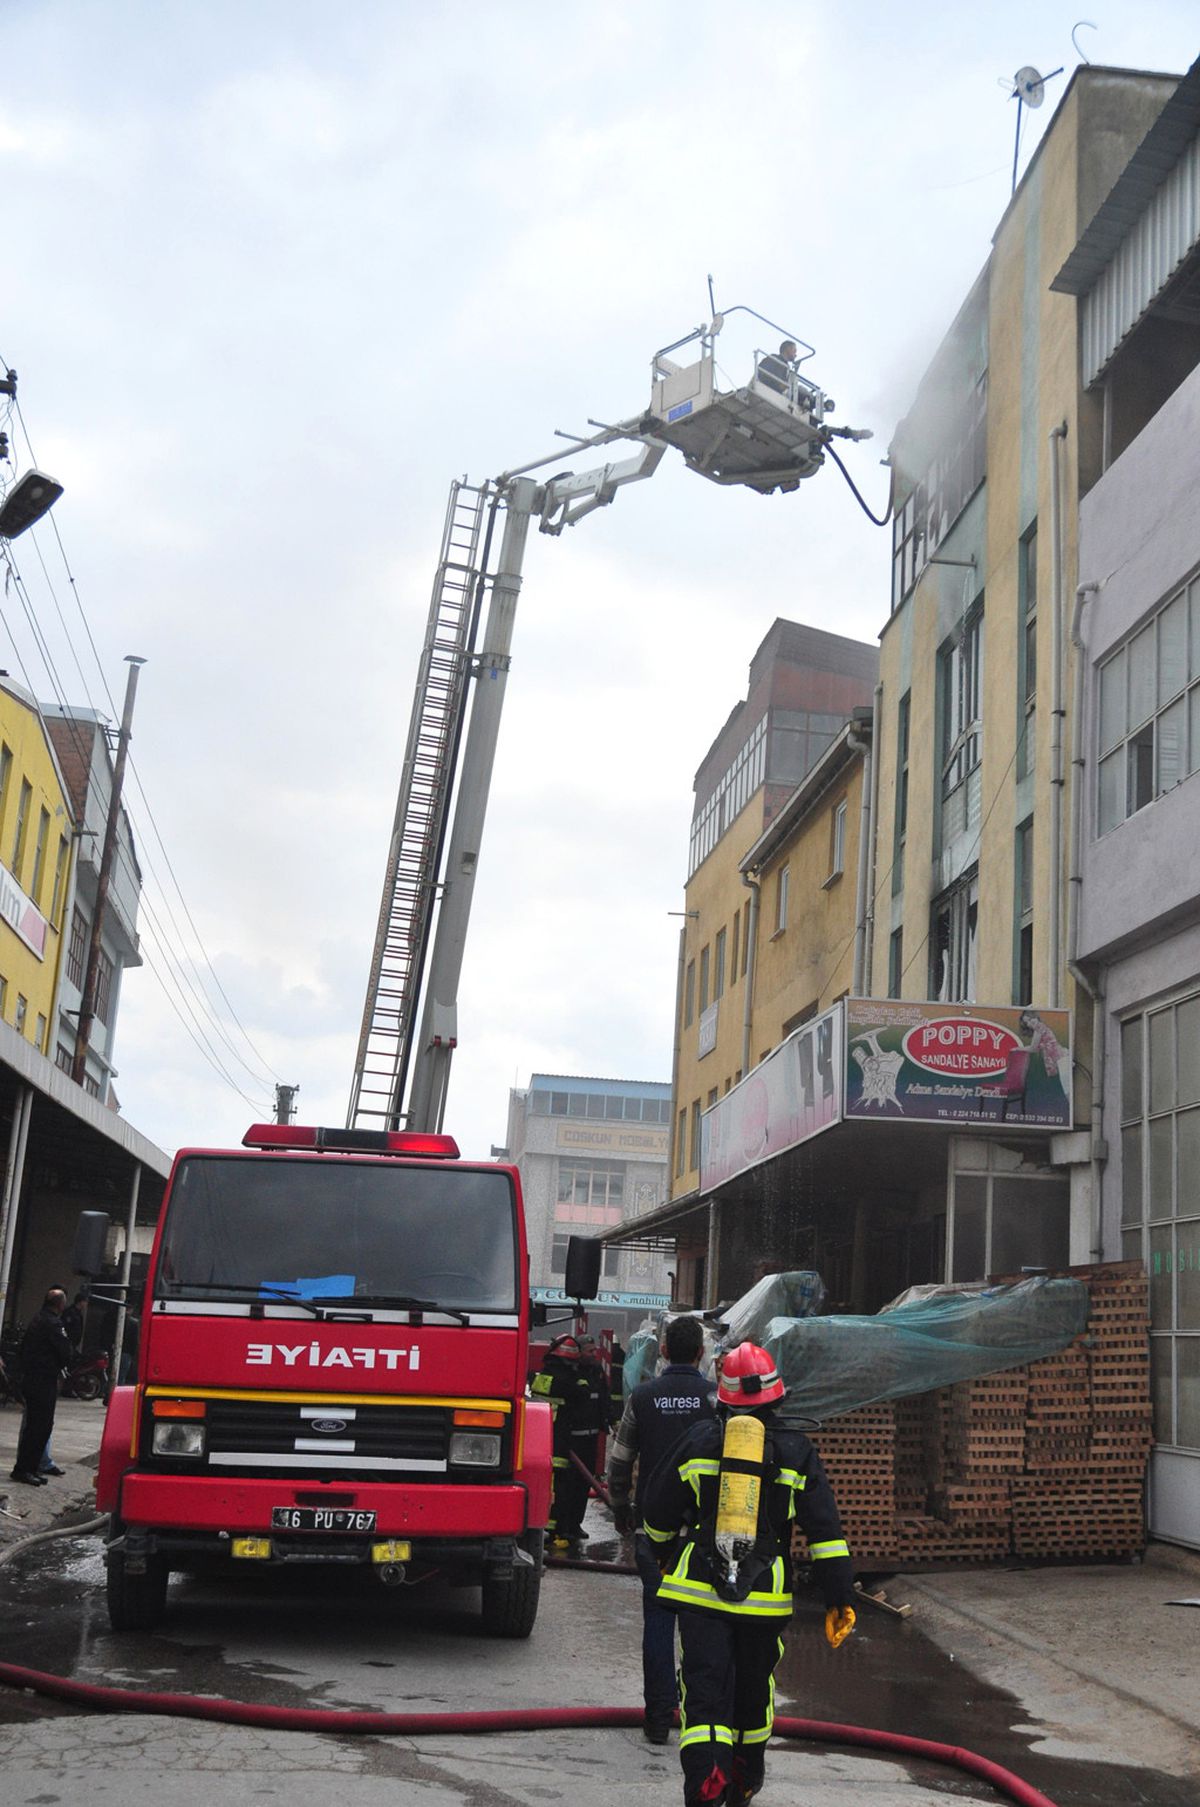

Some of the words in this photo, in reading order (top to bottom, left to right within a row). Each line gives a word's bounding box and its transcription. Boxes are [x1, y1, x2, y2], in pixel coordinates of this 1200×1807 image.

[922, 1025, 1006, 1050] POPPY
[921, 1053, 969, 1069] SANDALYE
[314, 1511, 334, 1529] PU
[346, 1513, 375, 1530] 767
